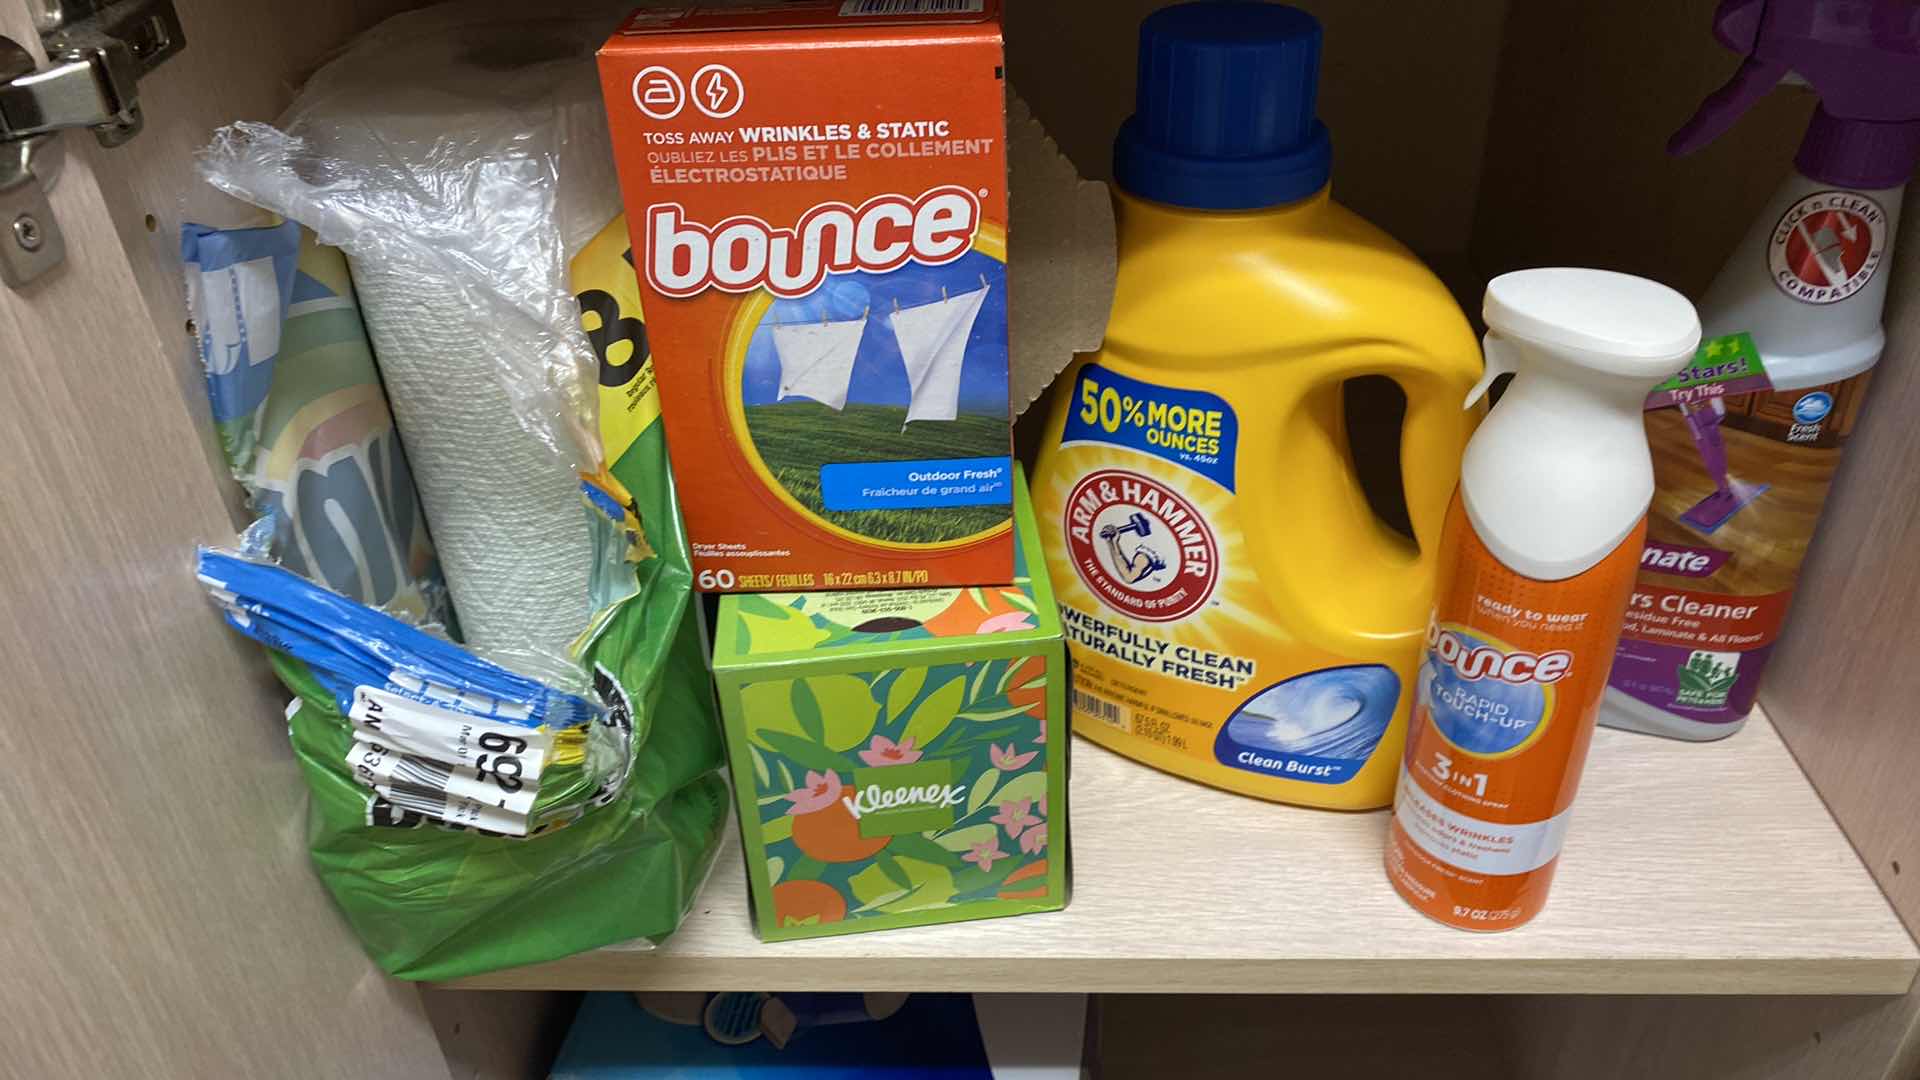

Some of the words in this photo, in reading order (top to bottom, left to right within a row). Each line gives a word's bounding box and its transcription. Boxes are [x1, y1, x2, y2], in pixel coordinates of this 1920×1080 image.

[643, 132, 685, 145] TOSS
[689, 130, 735, 144] AWAY
[739, 124, 852, 143] WRINKLES
[857, 123, 871, 139] &
[876, 120, 950, 138] STATIC
[647, 151, 716, 164] OUBLIEZ
[720, 150, 749, 163] LES
[753, 145, 798, 162] PLIS
[803, 144, 829, 161] ET
[835, 143, 860, 160] LE
[866, 138, 993, 159] COLLEMENT
[650, 164, 847, 184] ÉLECTROSTATIQUE
[1830, 197, 1879, 224] CLEAN
[646, 186, 980, 298] bounce
[1778, 249, 1880, 300] COMPATIBLE
[1677, 356, 1749, 383] Stars!
[1669, 388, 1694, 402] Try
[1694, 383, 1726, 397] This
[1080, 377, 1145, 433] 50%
[1148, 400, 1223, 438] MORE
[1146, 427, 1220, 455] OUNCES
[908, 471, 960, 483] Outdoor
[963, 468, 998, 480] Fresh
[862, 486, 918, 498] Fraîcheur
[922, 485, 937, 496] de
[940, 484, 976, 497] grand
[979, 483, 994, 493] air
[1071, 487, 1102, 545] ARM
[1099, 480, 1120, 503] &
[1121, 480, 1209, 577] HAMMER
[698, 568, 735, 589] 60
[1083, 557, 1100, 576] THE
[1095, 574, 1143, 609] STANDARD
[1157, 586, 1188, 609] PURITY
[1477, 594, 1522, 618] ready
[1525, 609, 1543, 621] to
[1546, 612, 1589, 623] wear
[1625, 610, 1669, 624] esidue
[1660, 594, 1758, 621] Cleaner
[1642, 624, 1696, 641] Laminate
[1175, 645, 1254, 676] CLEAN
[1162, 660, 1236, 689] FRESH
[1436, 684, 1530, 729] TOUCH-UP
[1456, 687, 1510, 716] RAPID
[1237, 751, 1283, 771] Clean
[1285, 760, 1332, 777] Burst
[842, 783, 966, 820] Kleenex
